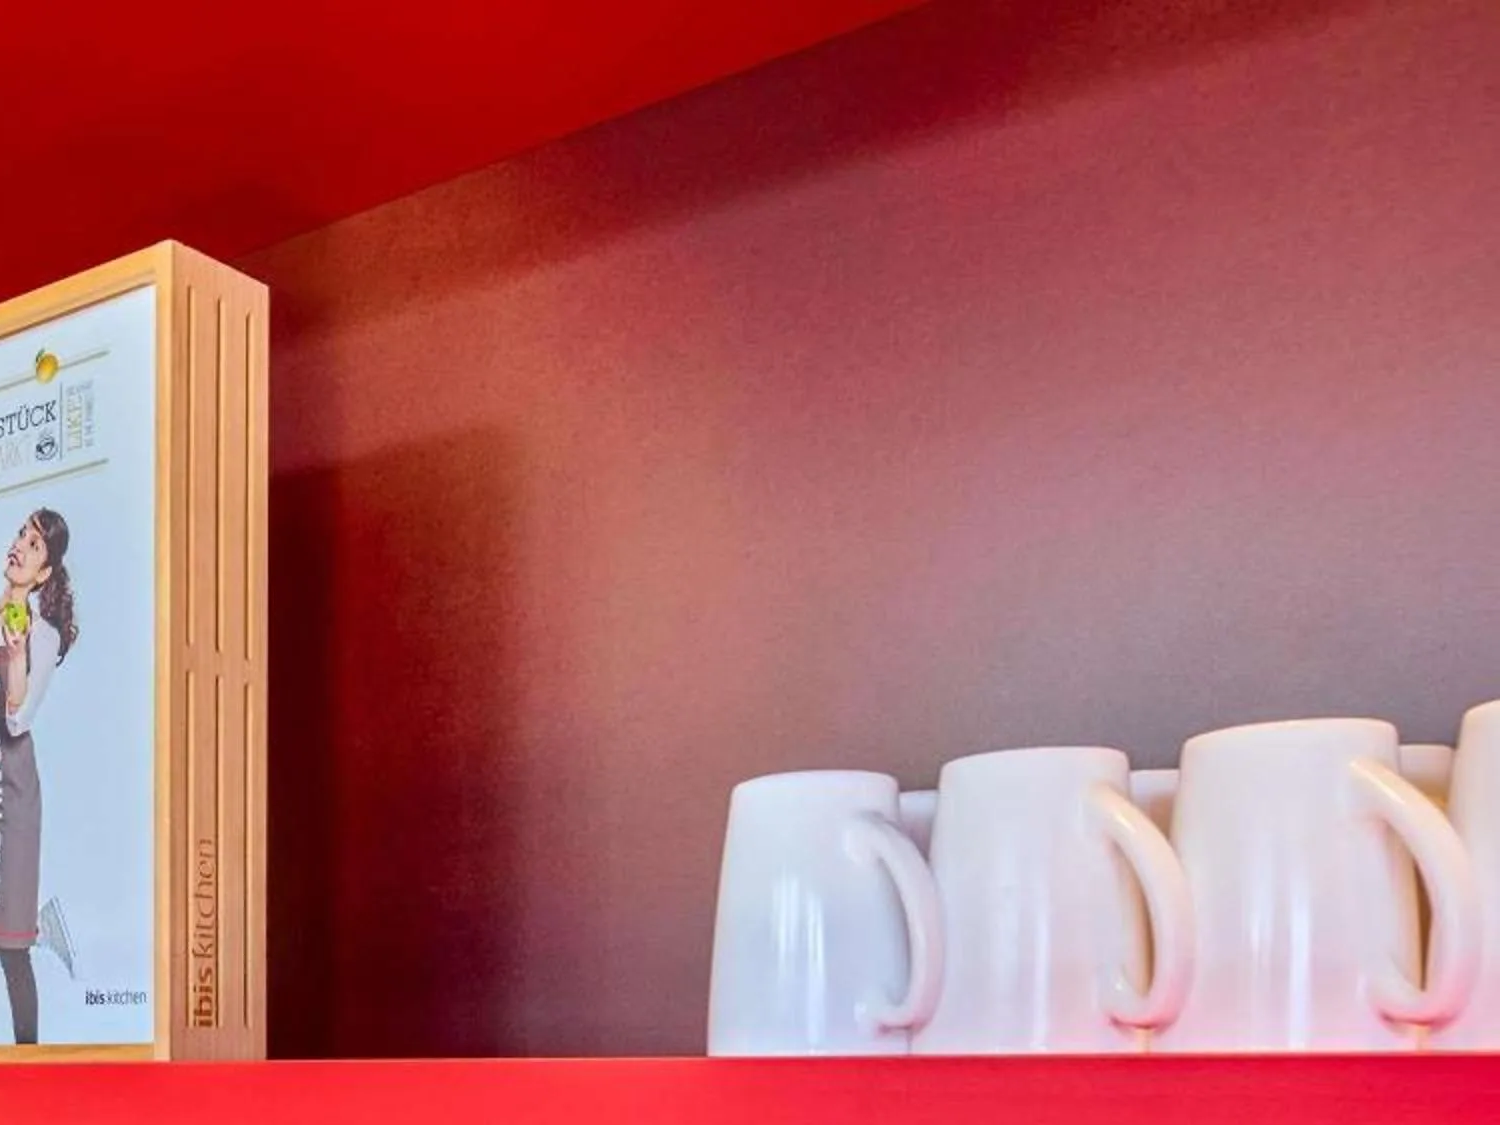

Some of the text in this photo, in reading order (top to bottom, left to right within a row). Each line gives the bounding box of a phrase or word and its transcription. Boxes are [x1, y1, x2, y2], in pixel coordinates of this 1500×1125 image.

[192, 838, 215, 1028] ibis kitchen
[85, 988, 147, 1005] ibis kitchen
